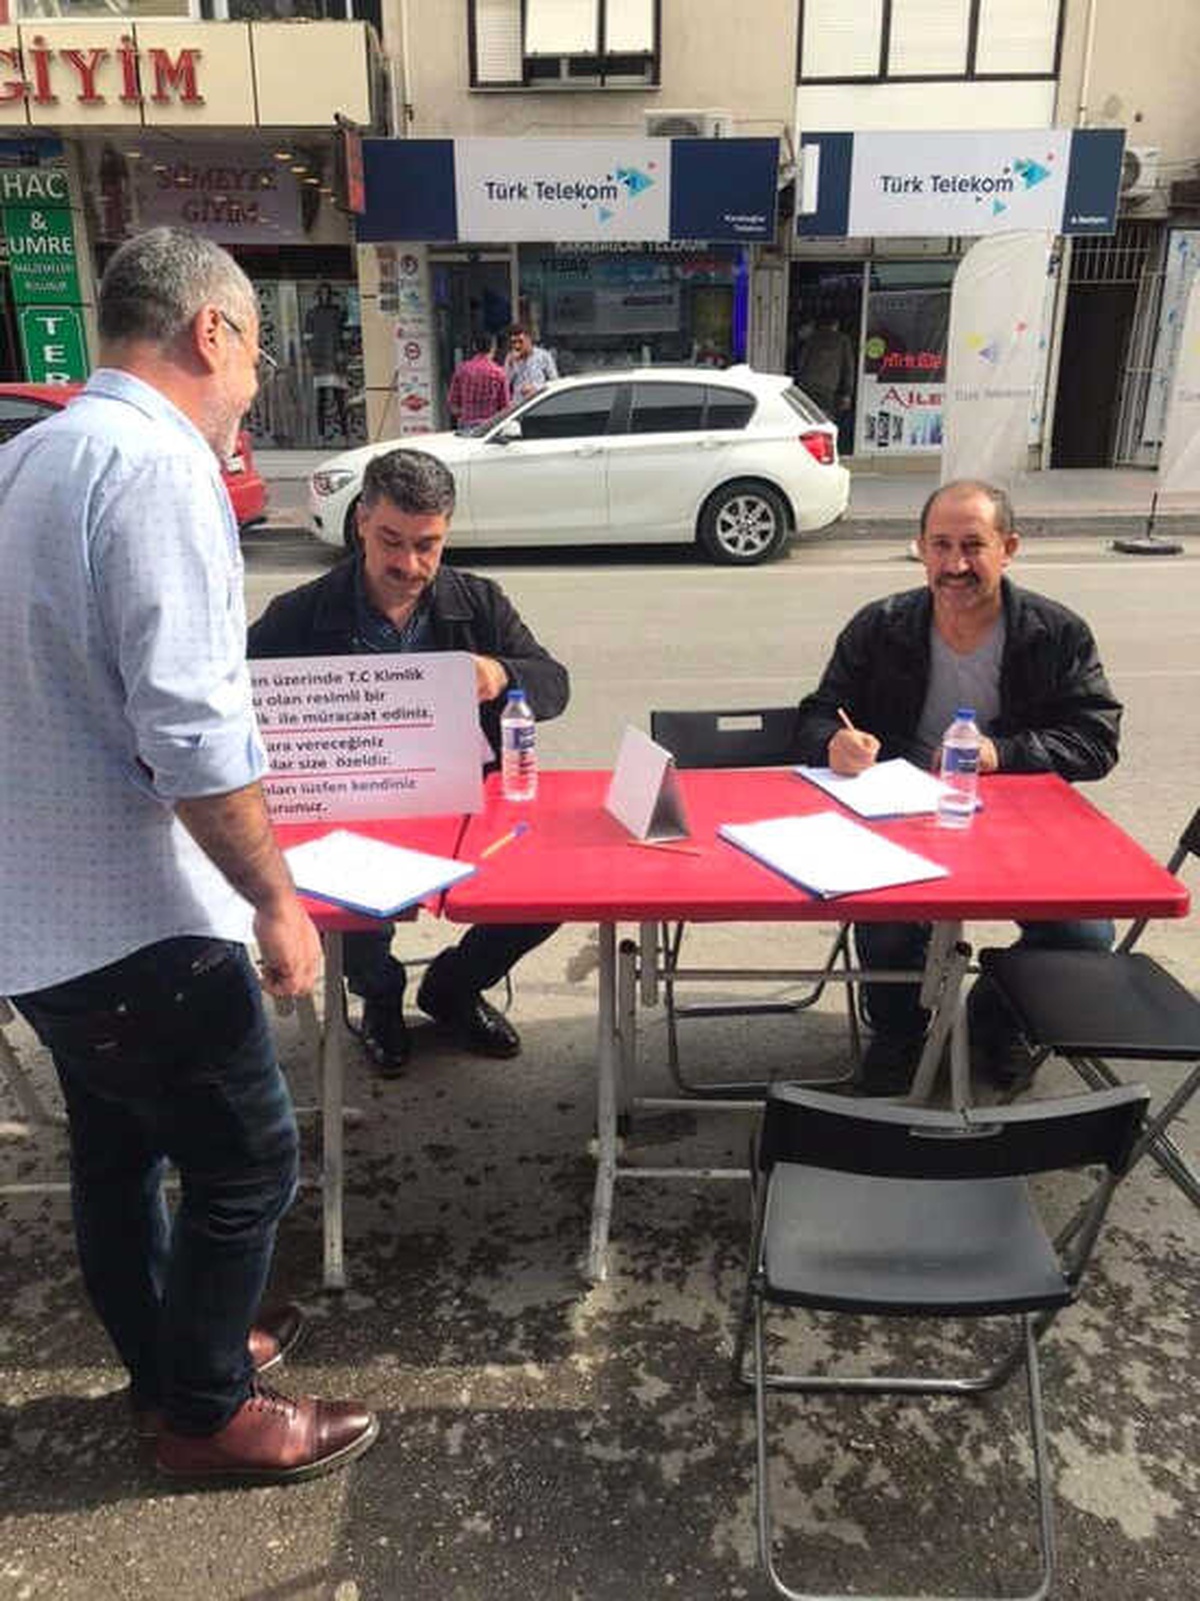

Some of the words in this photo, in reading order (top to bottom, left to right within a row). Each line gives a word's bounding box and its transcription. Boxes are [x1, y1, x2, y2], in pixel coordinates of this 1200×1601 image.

[3, 173, 65, 199] HAC
[484, 180, 528, 200] Türk
[535, 179, 618, 200] Telekom
[880, 175, 922, 192] Türk
[931, 175, 1014, 193] Telekom
[30, 211, 48, 230] &
[10, 236, 72, 255] UMRE
[273, 671, 342, 686] üzerinde
[347, 670, 369, 682] T.C
[374, 668, 424, 681] Kimlik
[266, 694, 302, 706] olan
[306, 690, 360, 704] resimli
[364, 690, 385, 702] bir
[278, 712, 298, 724] ile
[302, 710, 377, 723] müracaat
[296, 736, 384, 752] vereceğiniz
[299, 759, 327, 769] size
[301, 781, 347, 794] lütfen
